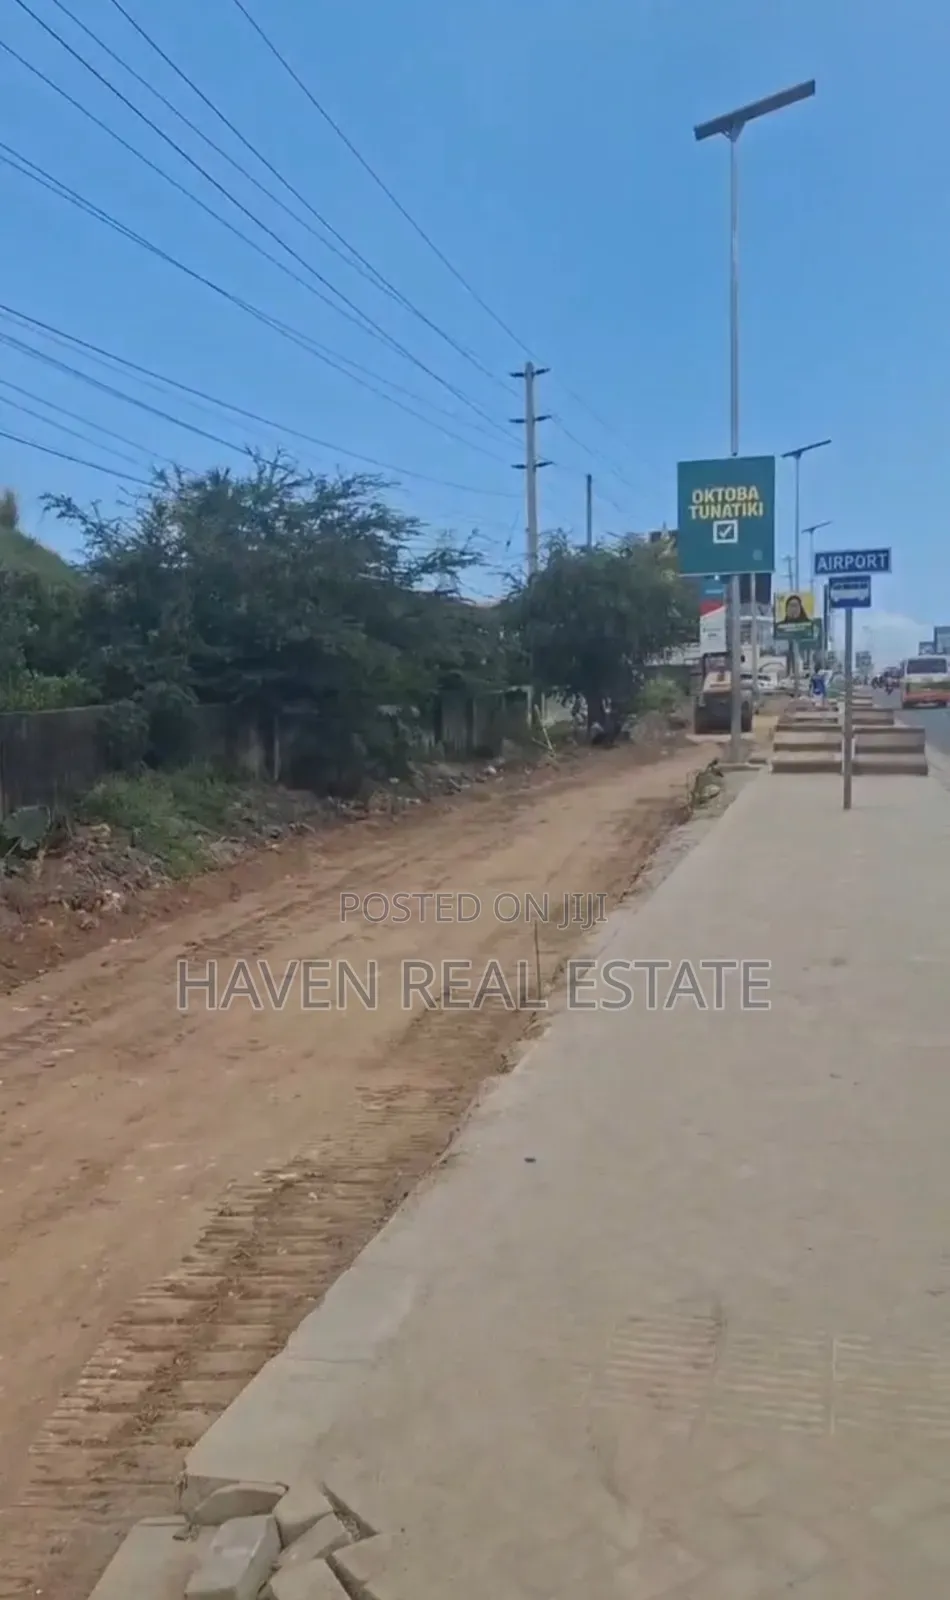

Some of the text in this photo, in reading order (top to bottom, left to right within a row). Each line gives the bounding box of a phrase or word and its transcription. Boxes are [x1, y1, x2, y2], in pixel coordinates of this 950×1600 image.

[692, 485, 759, 504] OKTOBA
[689, 502, 764, 519] TUNATIKI
[817, 554, 887, 571] AIRPORT
